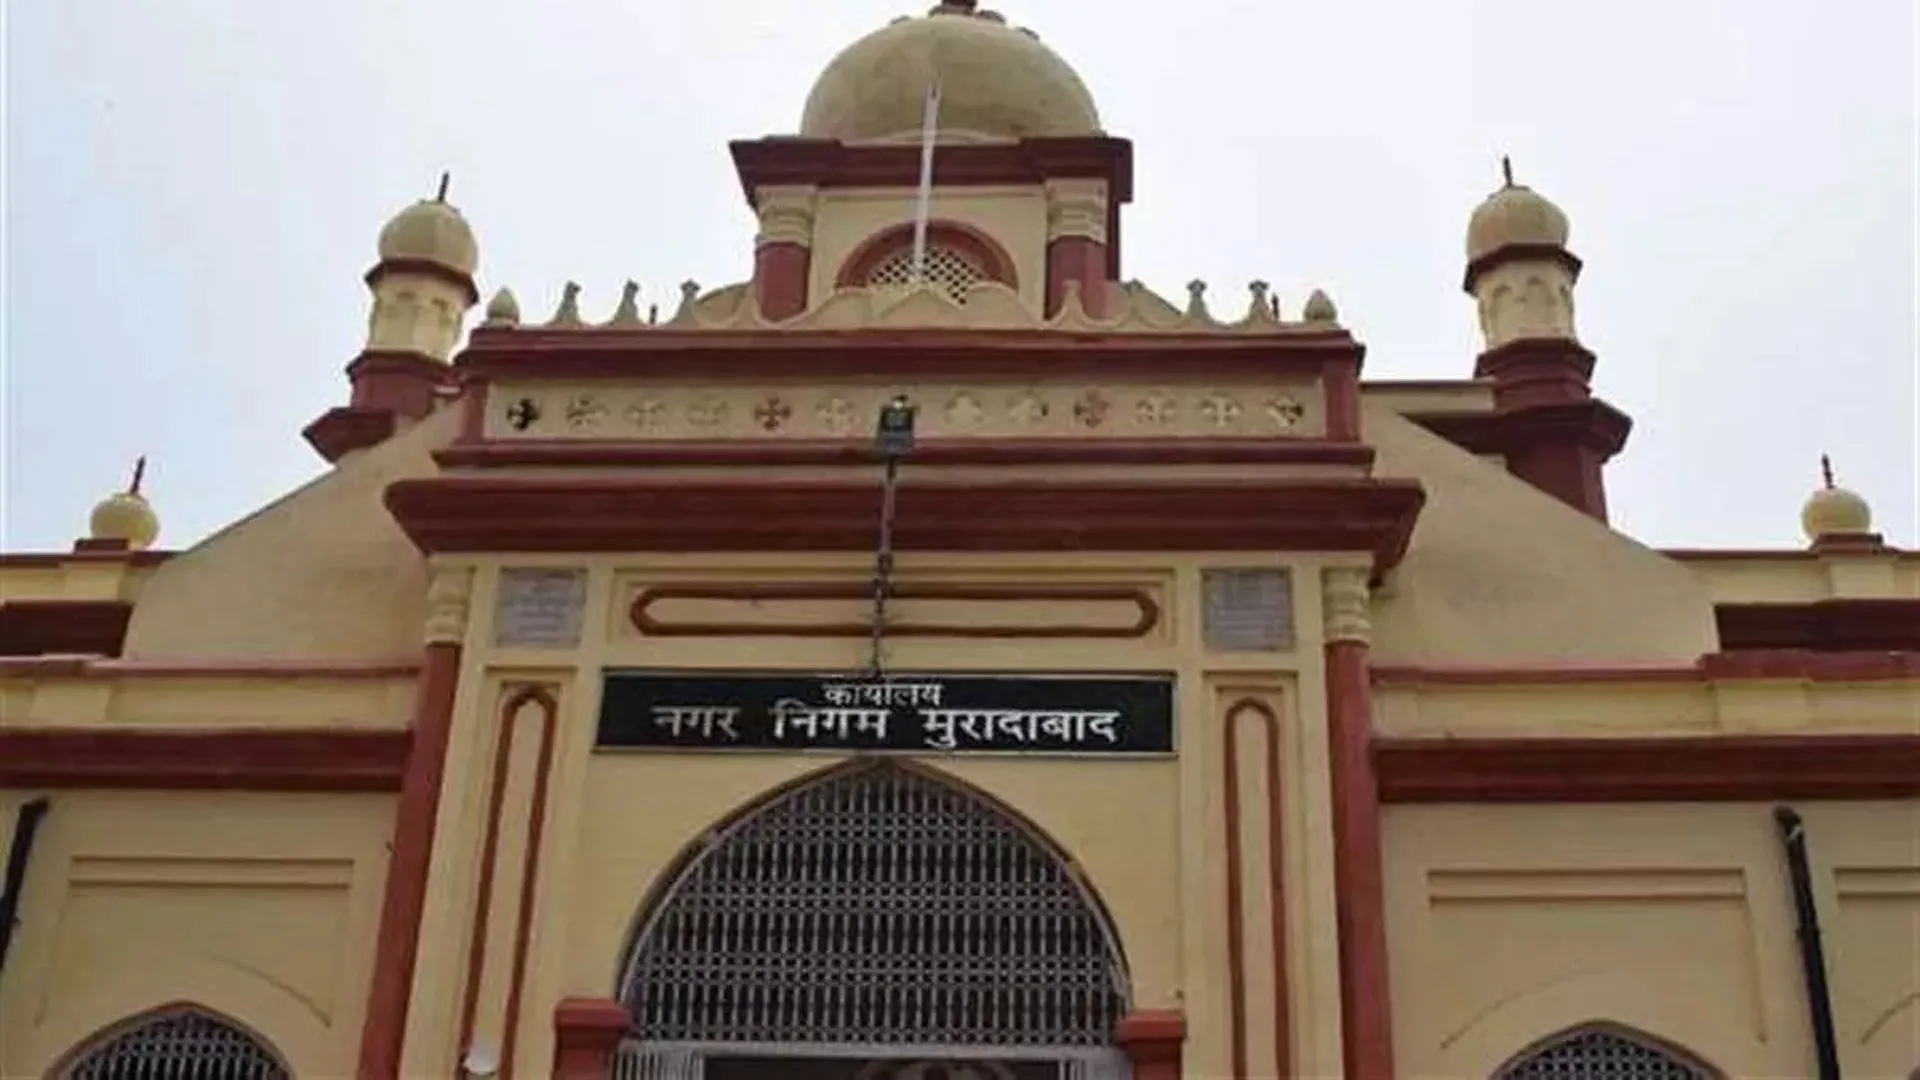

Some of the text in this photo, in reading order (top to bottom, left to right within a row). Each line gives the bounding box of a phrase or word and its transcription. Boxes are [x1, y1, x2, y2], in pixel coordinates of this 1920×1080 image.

[651, 698, 1121, 747] नगर निगम मुरादाबाद
